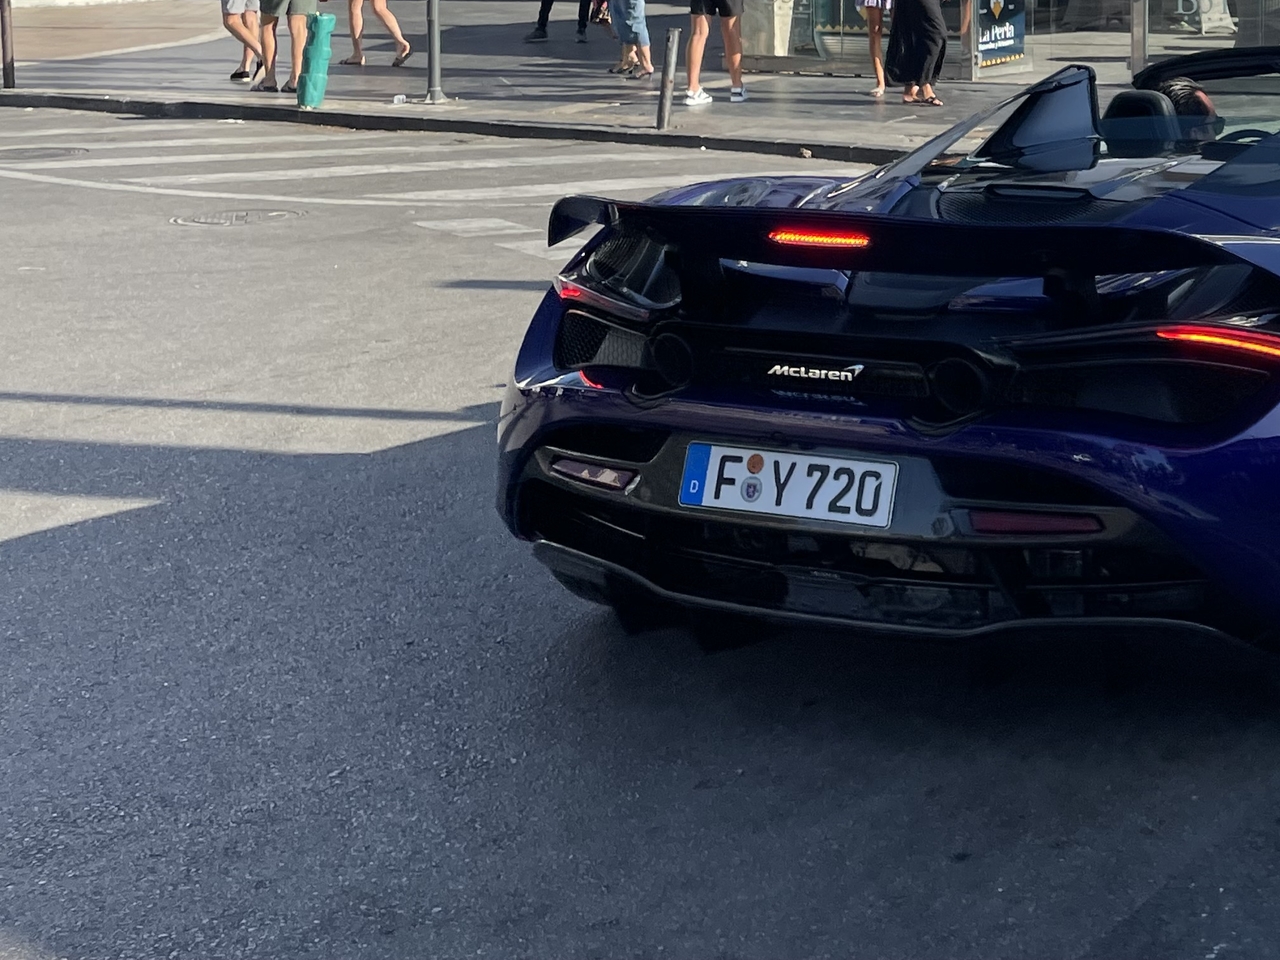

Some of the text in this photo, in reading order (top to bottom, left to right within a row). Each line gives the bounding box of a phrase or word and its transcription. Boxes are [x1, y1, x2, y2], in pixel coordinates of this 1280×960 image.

[991, 22, 1015, 41] Perla
[767, 364, 853, 382] McLaren
[713, 454, 744, 501] F
[689, 480, 699, 494] D
